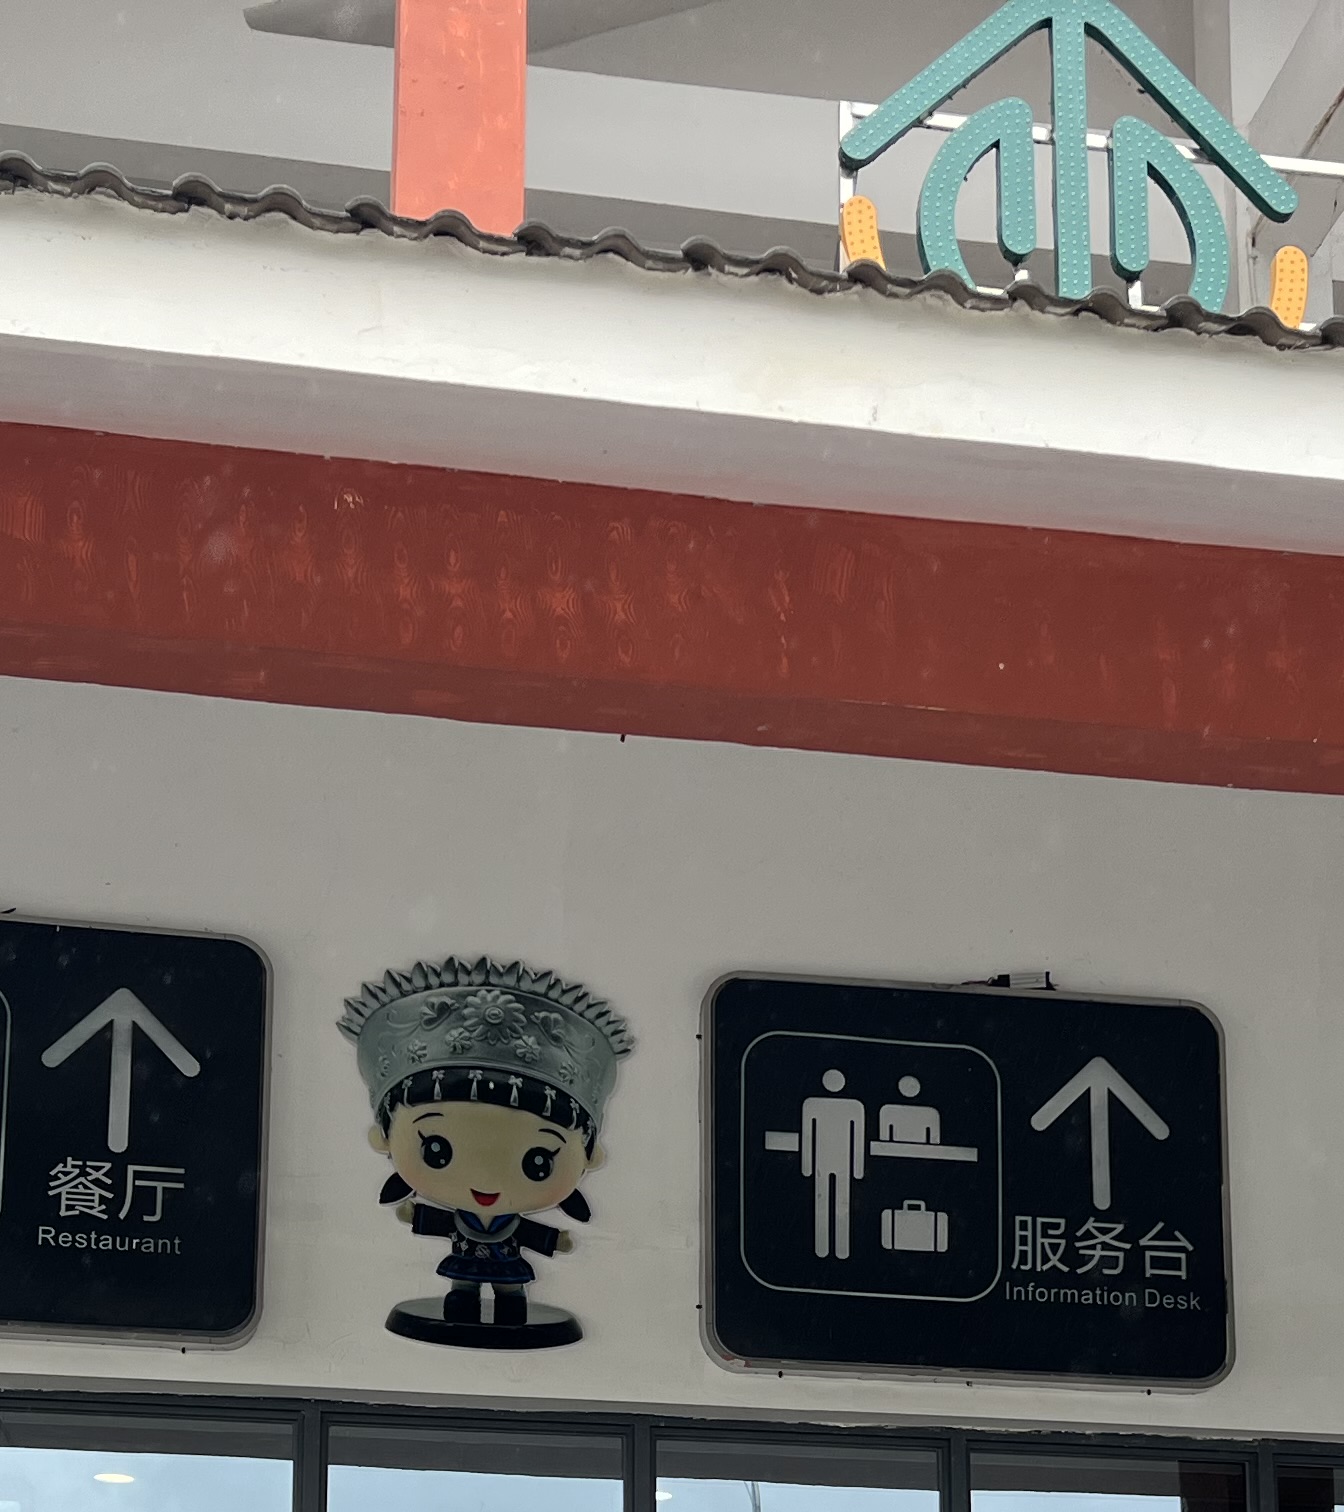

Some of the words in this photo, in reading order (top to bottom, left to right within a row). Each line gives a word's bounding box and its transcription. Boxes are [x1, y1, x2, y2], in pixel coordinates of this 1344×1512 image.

[47, 1157, 185, 1222] 餐厅
[37, 1226, 182, 1255] Restaurant
[1011, 1216, 1194, 1280] 服务台
[1005, 1281, 1138, 1308] Information
[1144, 1288, 1203, 1311] Desk
